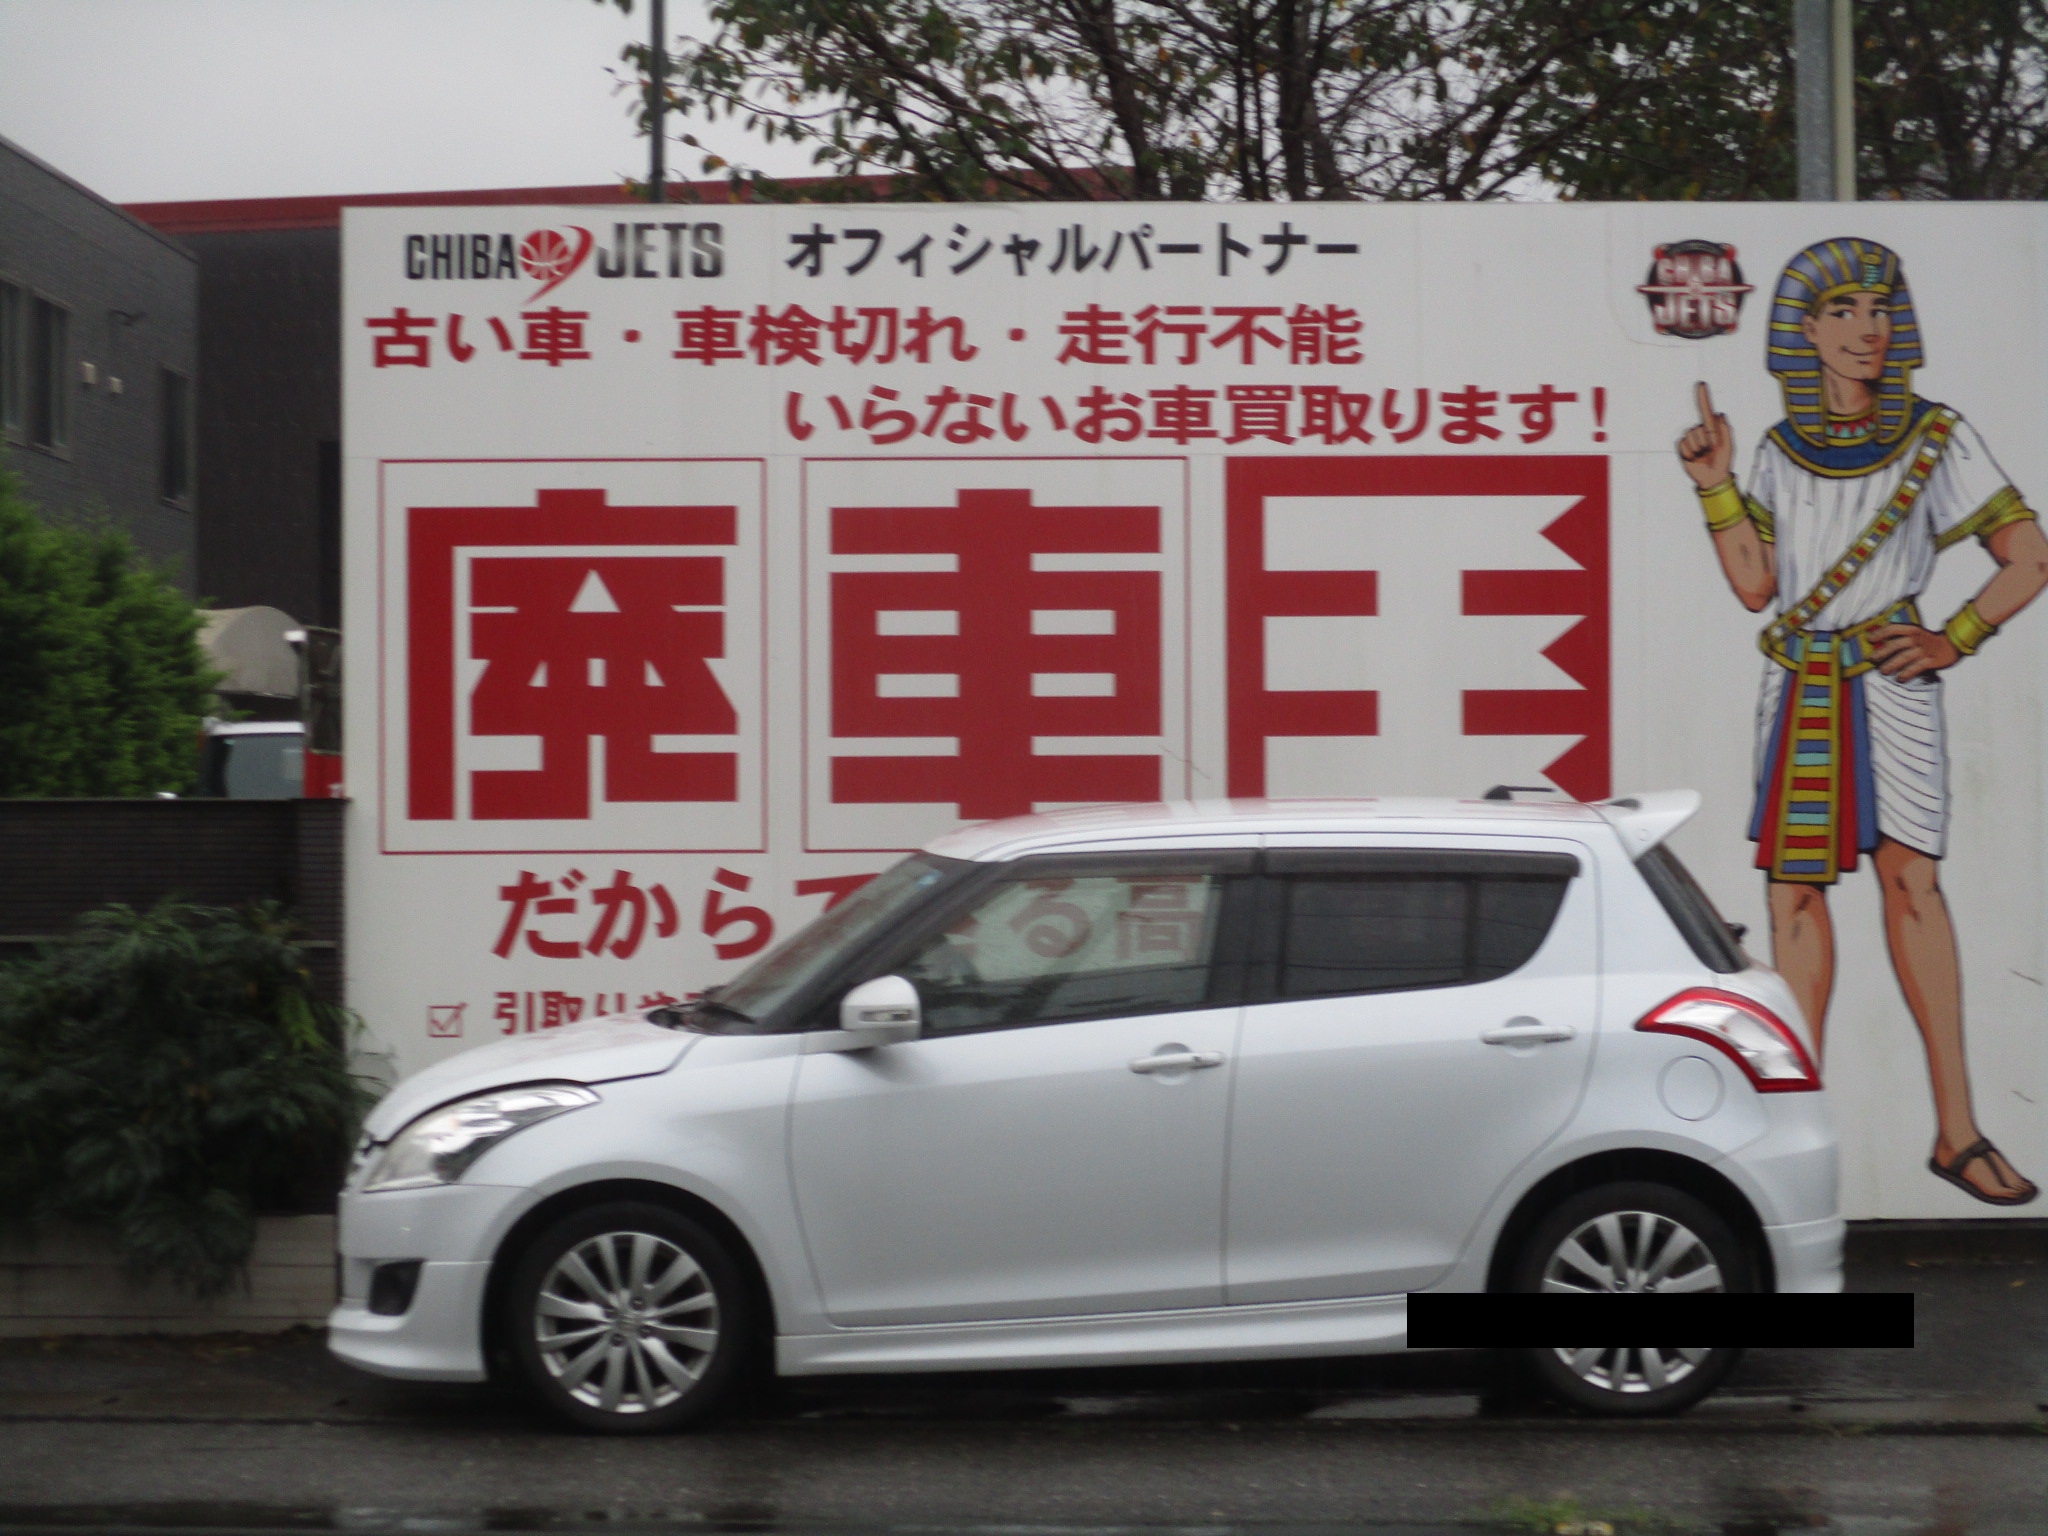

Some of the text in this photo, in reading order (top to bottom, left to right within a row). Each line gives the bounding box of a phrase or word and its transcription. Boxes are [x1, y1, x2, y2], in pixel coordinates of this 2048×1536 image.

[404, 221, 1360, 280] CHIBA JETS オフィシャルパートナー
[365, 302, 1364, 368] 古い車・車検切れ・走行不能
